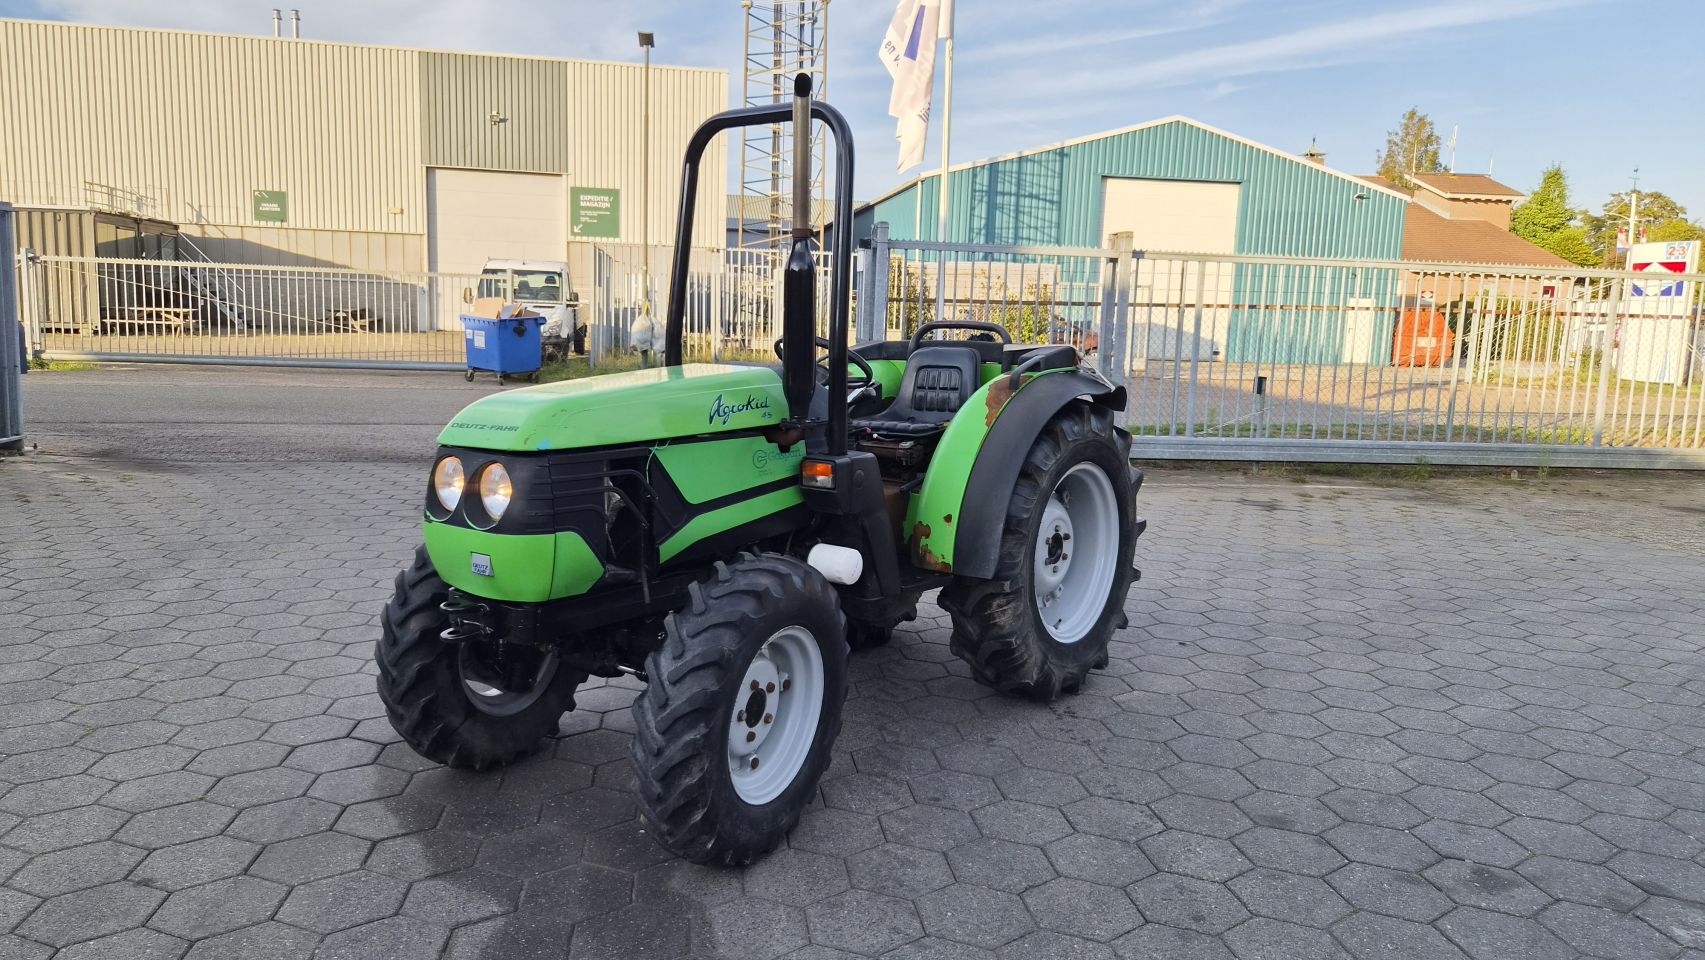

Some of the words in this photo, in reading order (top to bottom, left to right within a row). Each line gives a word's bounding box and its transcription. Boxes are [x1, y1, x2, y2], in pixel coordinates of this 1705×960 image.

[1667, 246, 1687, 257] 23
[709, 394, 770, 425] AgroKid
[761, 411, 772, 419] 45
[451, 422, 520, 432] DEUTZ-FAHR
